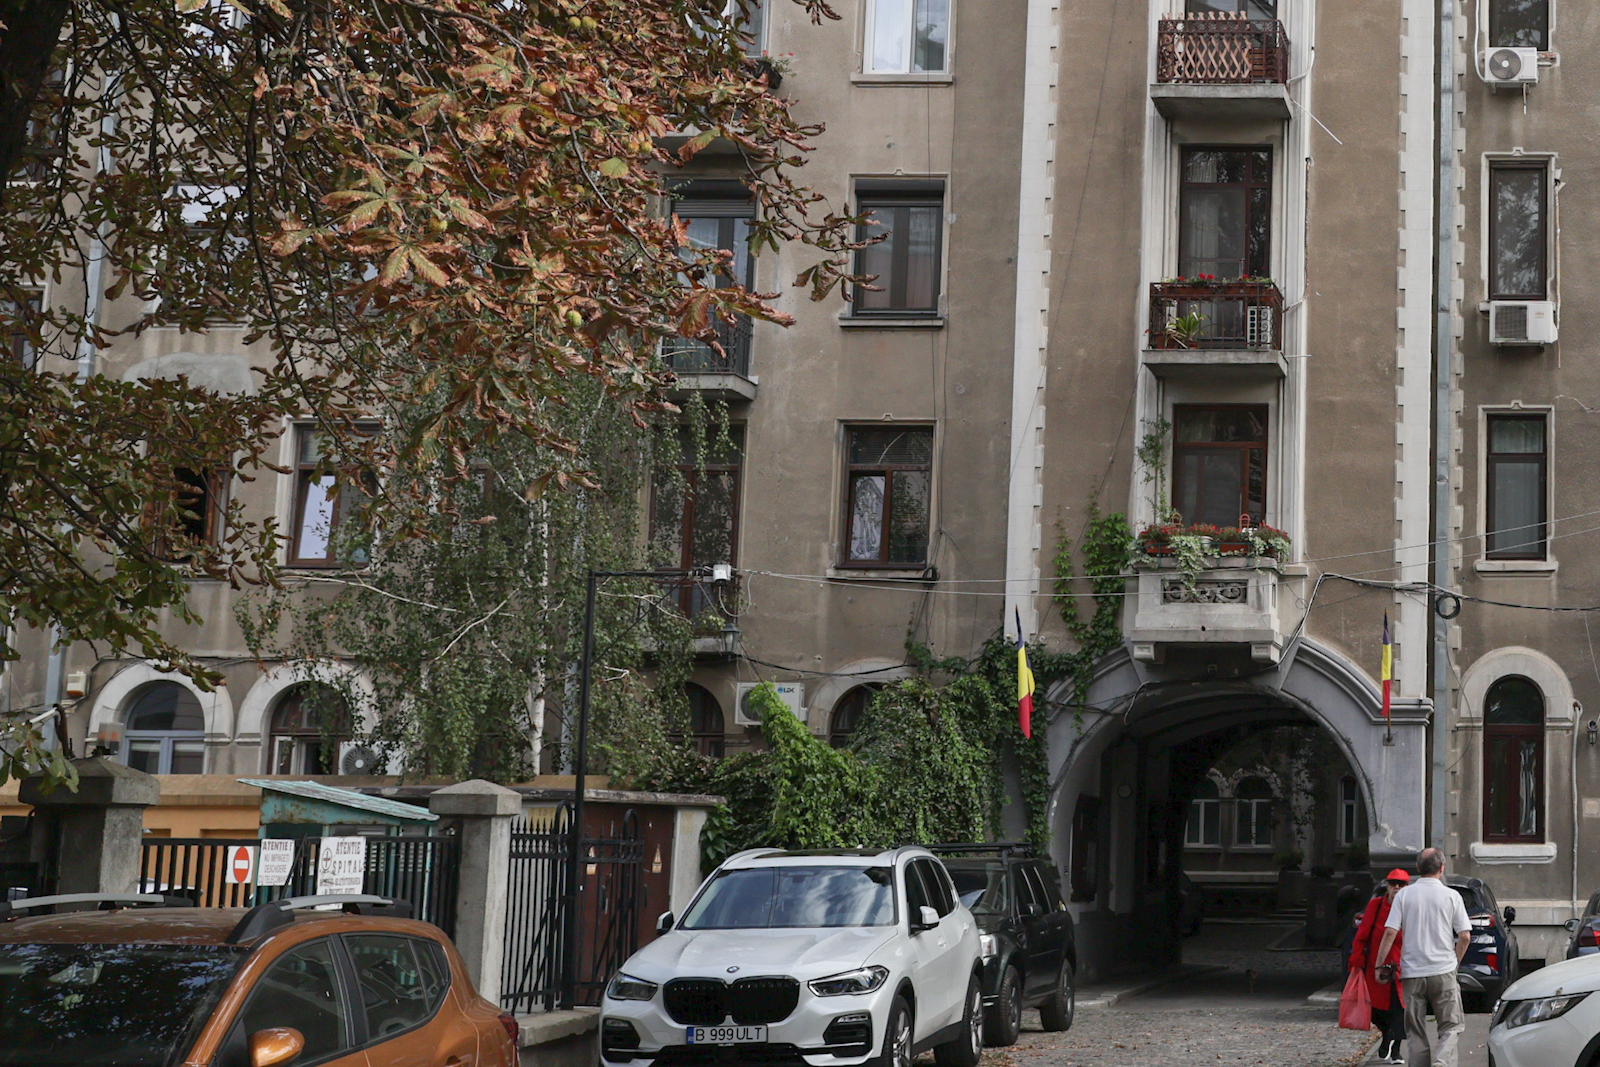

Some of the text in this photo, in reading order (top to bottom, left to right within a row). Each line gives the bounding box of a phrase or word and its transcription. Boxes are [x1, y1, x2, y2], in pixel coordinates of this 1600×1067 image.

[332, 860, 363, 873] SPITAL
[695, 1028, 705, 1041] B
[710, 1028, 734, 1041] 999
[736, 1027, 762, 1040] ULT
